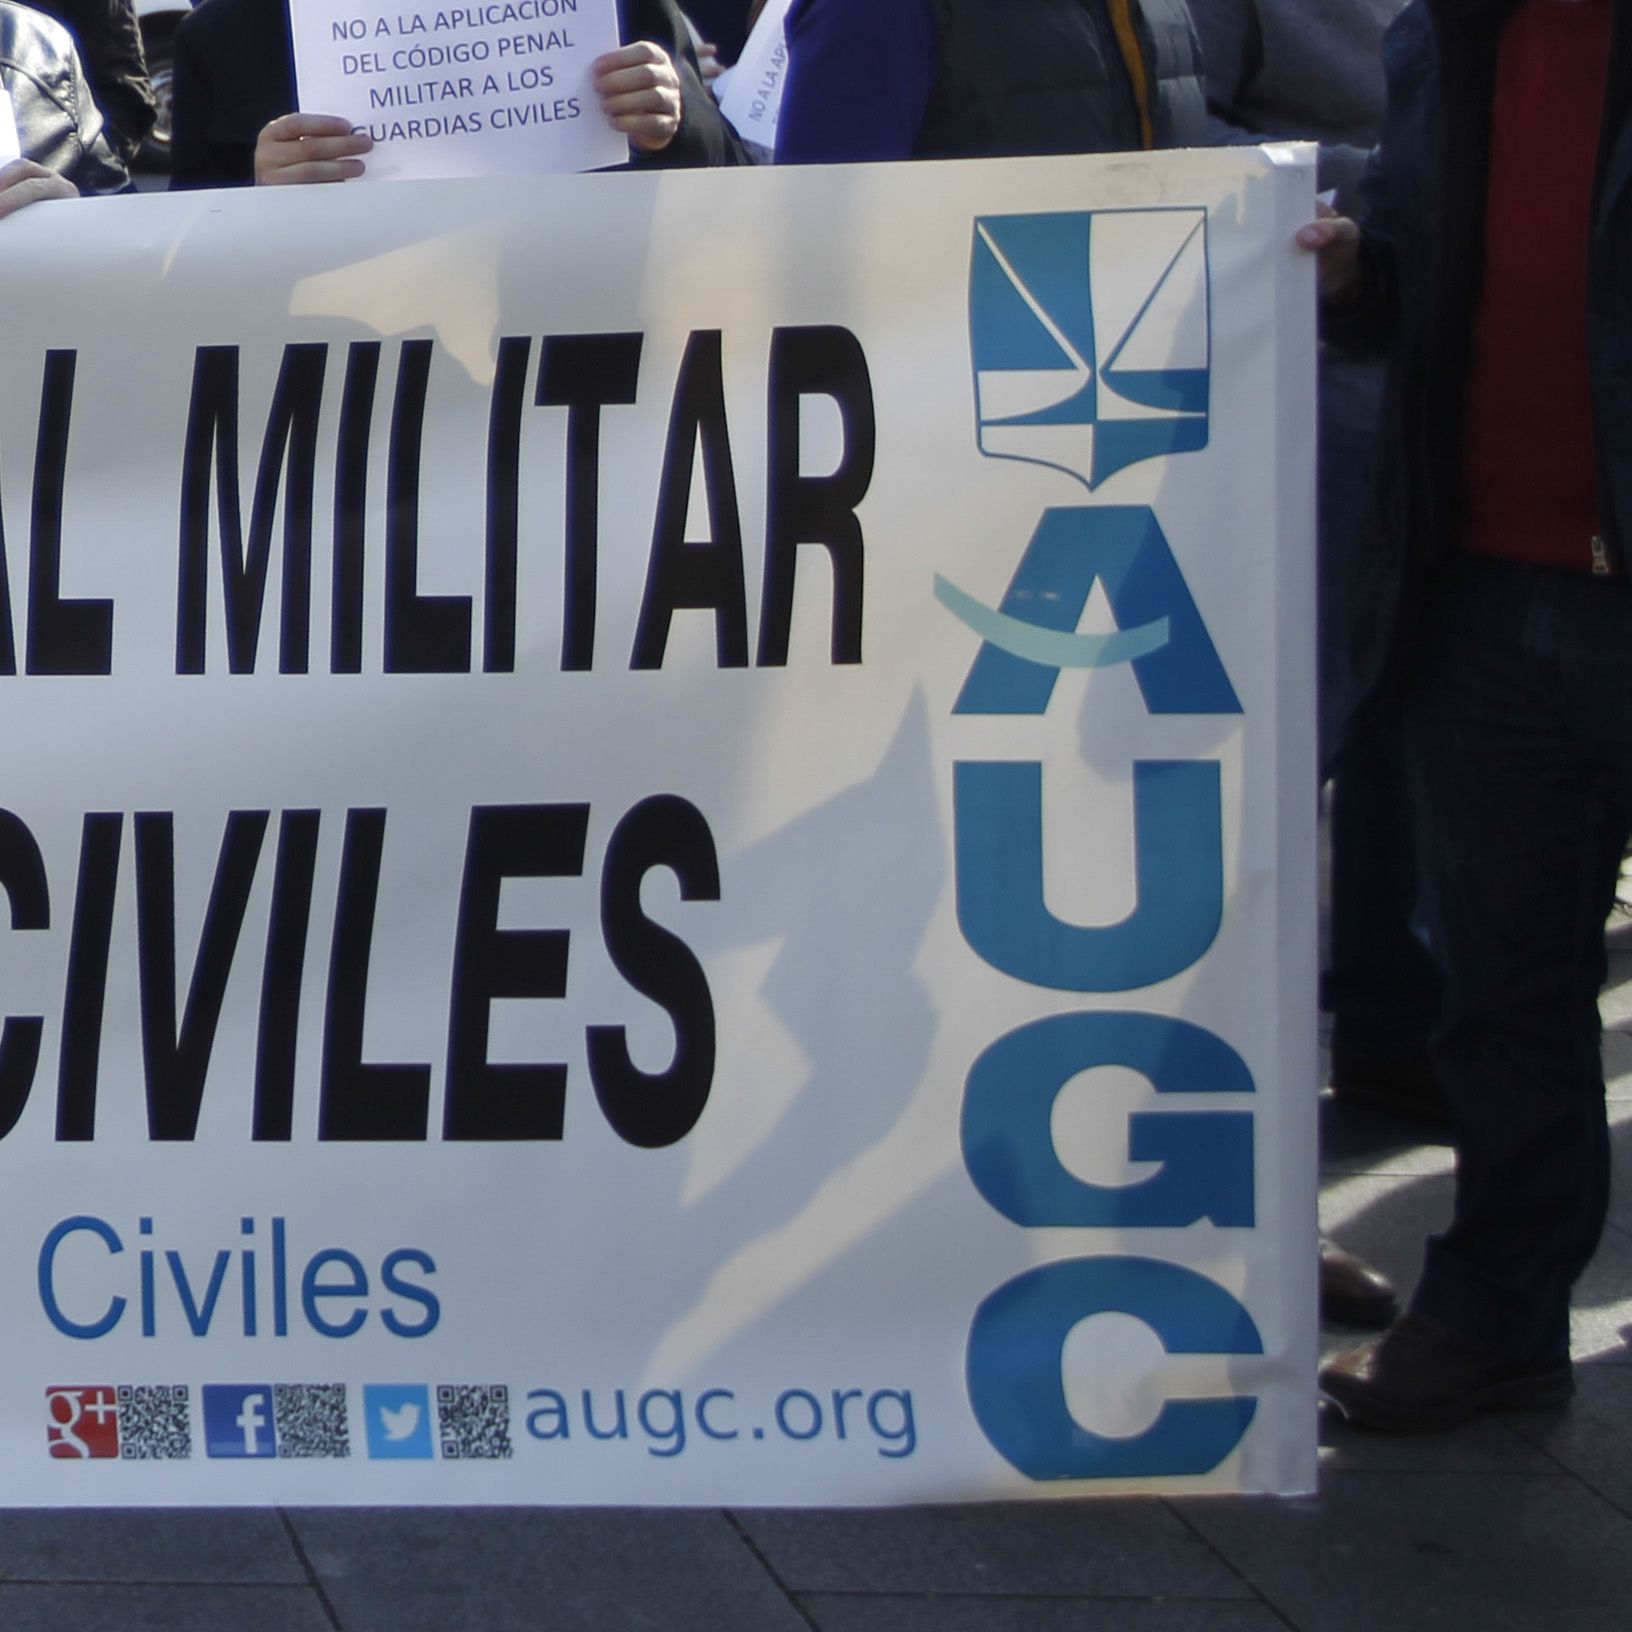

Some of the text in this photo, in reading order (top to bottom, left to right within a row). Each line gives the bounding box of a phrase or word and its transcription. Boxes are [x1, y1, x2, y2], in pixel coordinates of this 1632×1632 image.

[332, 19, 366, 41] NO
[375, 18, 391, 37] A
[398, 15, 427, 35] LA
[342, 29, 574, 75] DEL CÓDIGO PENAL
[370, 66, 553, 109] MILITAR A LOS
[490, 97, 581, 129] CIVILES
[176, 326, 875, 674] MILITAR
[936, 505, 1264, 1481] AUGC
[39, 1217, 440, 1339] Civiles
[526, 1388, 918, 1459] augc.org
